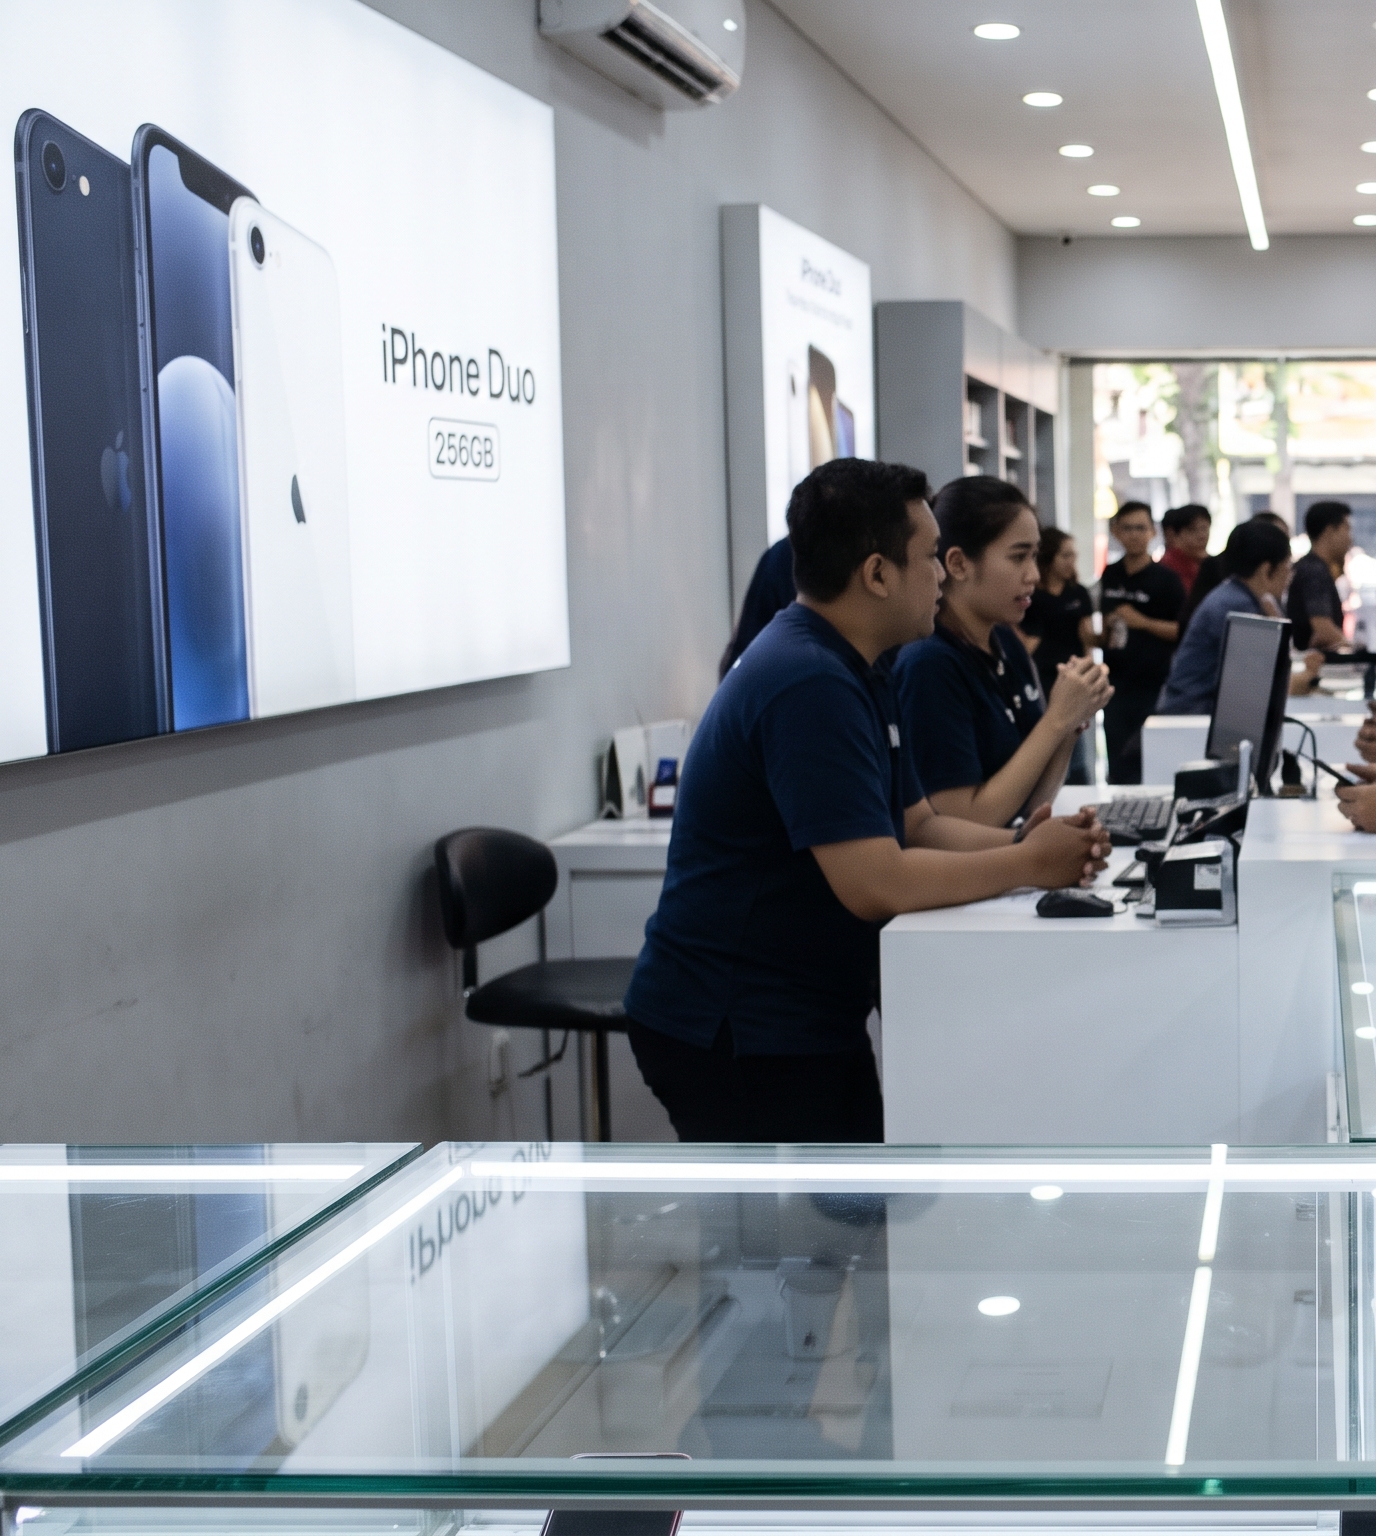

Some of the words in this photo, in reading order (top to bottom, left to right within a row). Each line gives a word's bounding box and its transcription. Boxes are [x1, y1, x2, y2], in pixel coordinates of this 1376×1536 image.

[381, 322, 480, 397] iPhone
[488, 348, 536, 405] Duo
[435, 431, 494, 468] 256GB
